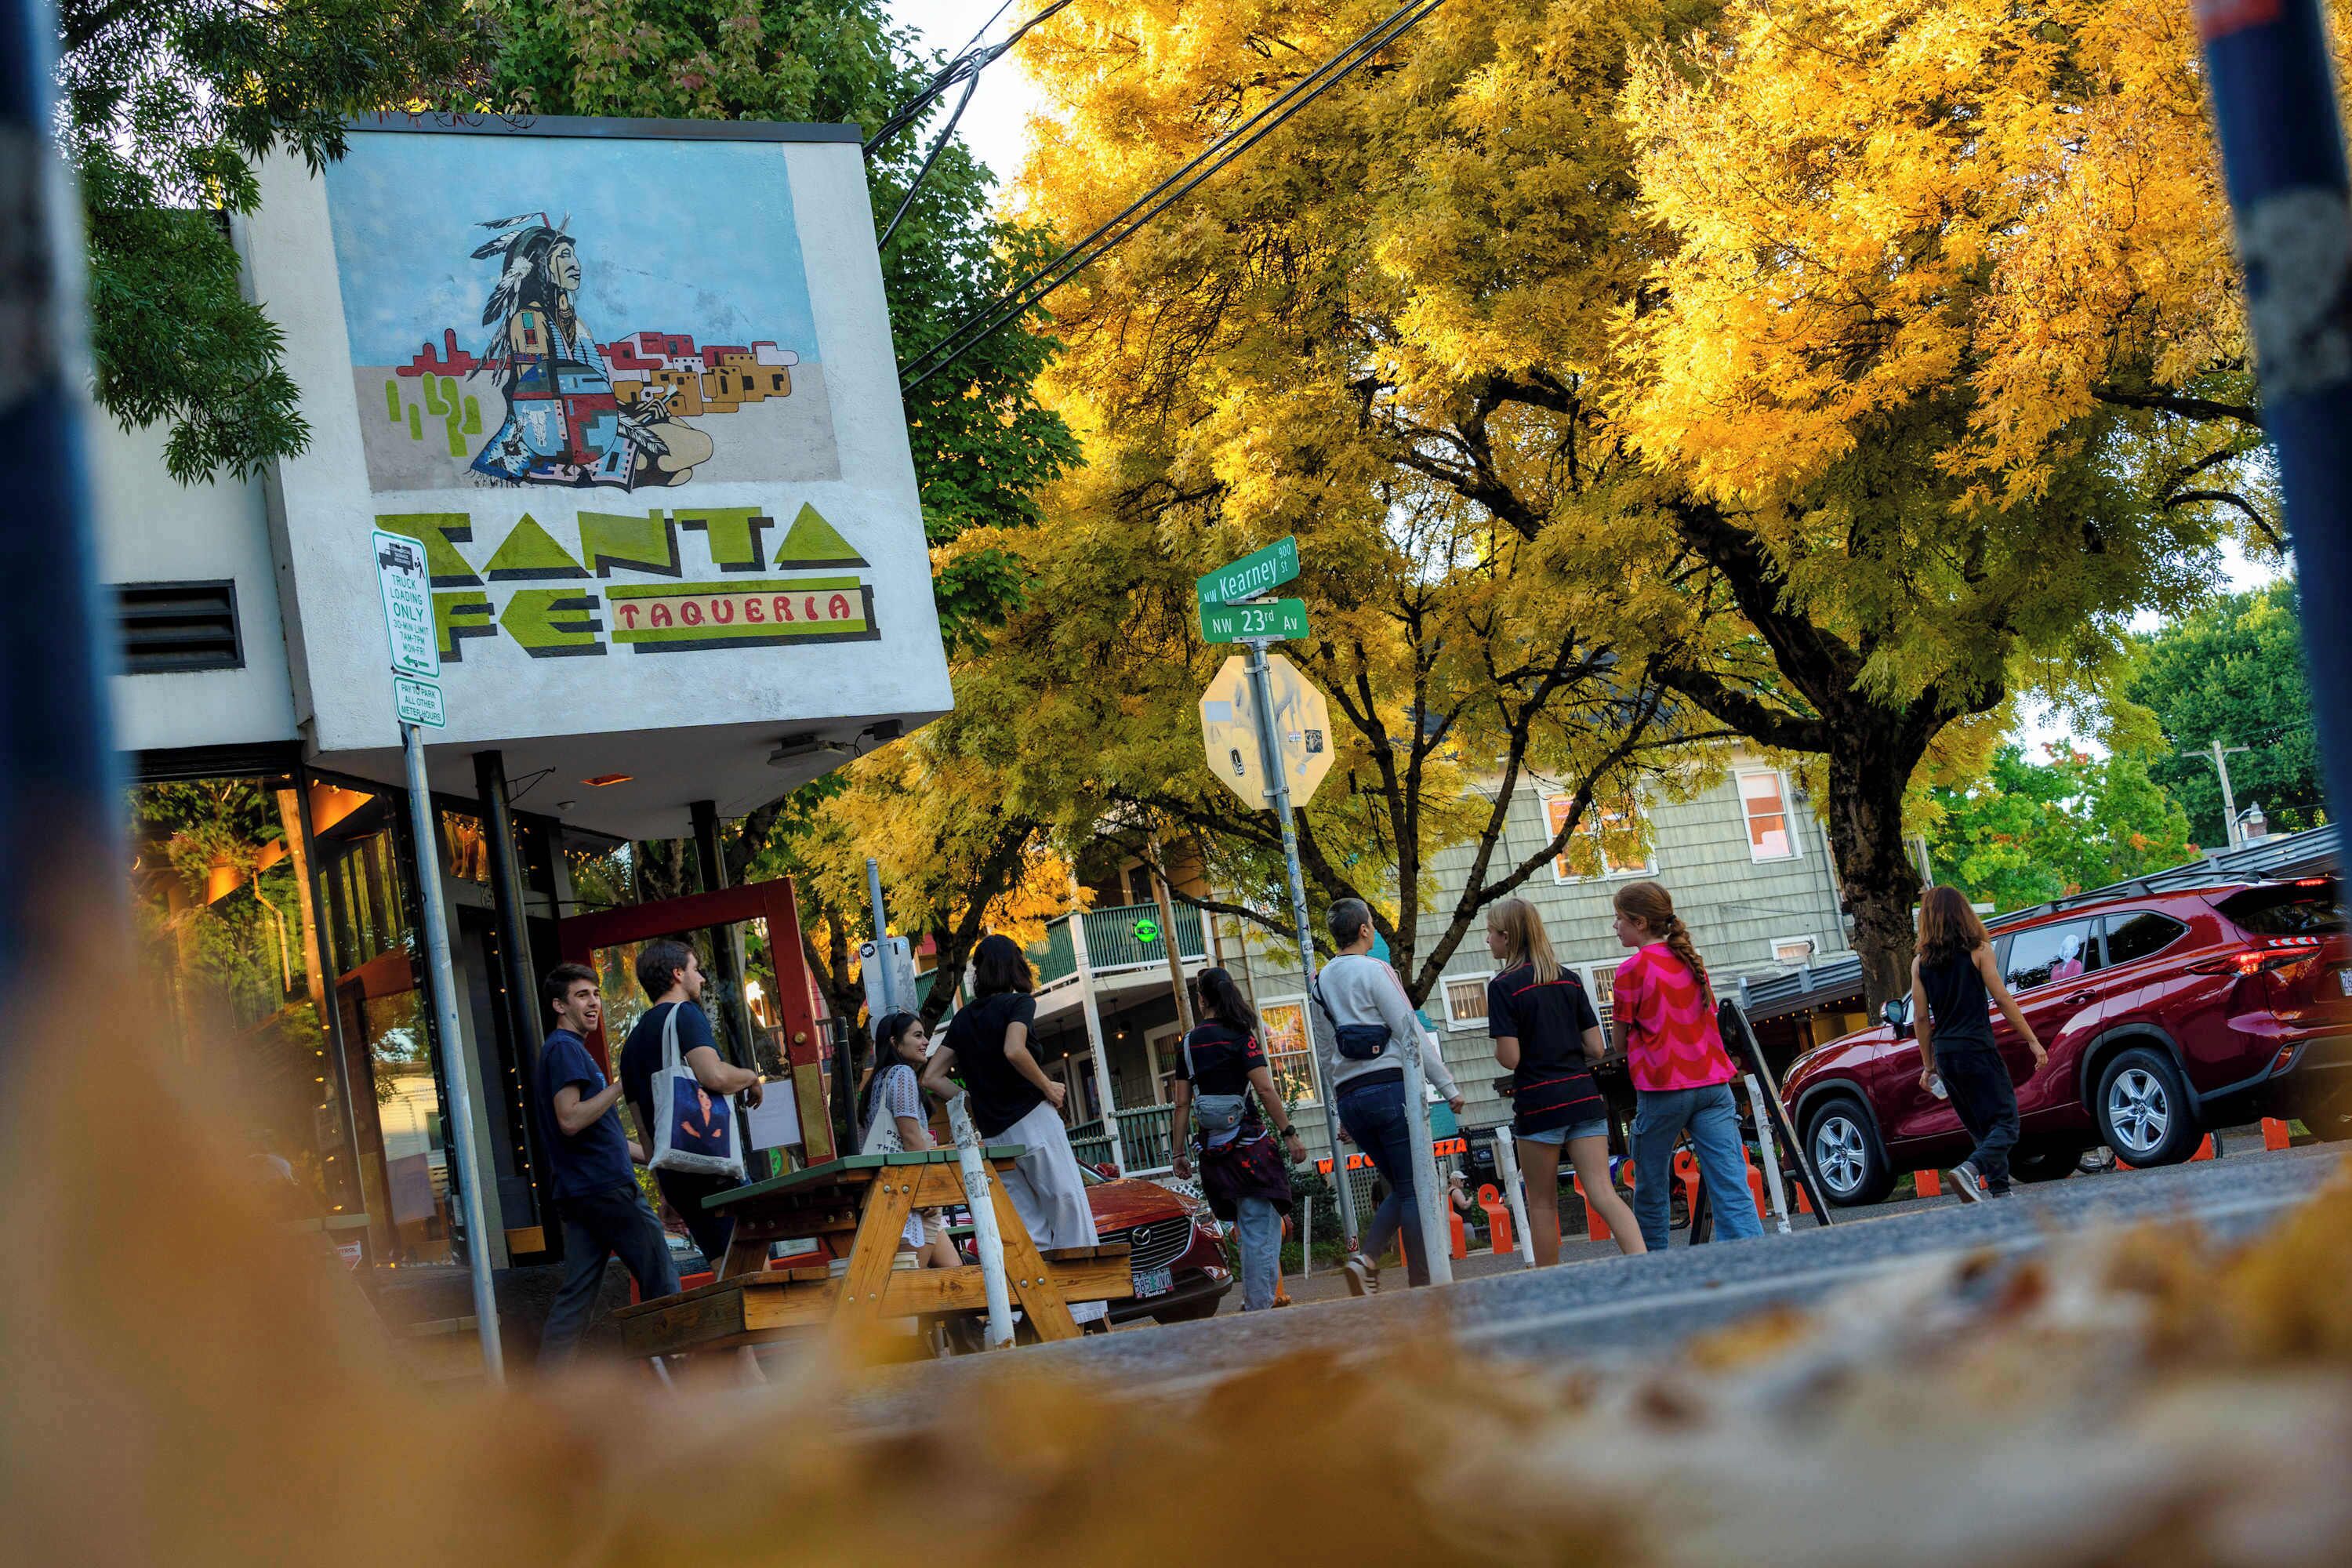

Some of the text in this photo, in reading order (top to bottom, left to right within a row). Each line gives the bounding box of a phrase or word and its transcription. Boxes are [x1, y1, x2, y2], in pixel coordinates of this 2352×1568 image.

[1279, 543, 1291, 559] 900
[392, 574, 416, 590] TRUCK
[1204, 557, 1288, 602] NW Kearney St
[390, 587, 423, 605] LOADING
[394, 602, 423, 622] ONLY
[620, 594, 850, 629] TAQUERIA
[394, 619, 429, 636] 30-MIN LIMIT
[1212, 609, 1298, 633] NW 23rd Av
[400, 630, 424, 644] 7AM-7PM
[402, 643, 425, 655] MON-FRI
[401, 684, 412, 693] PAY
[421, 688, 436, 699] PARK
[405, 695, 436, 709] ALL OTHER
[401, 706, 441, 721] METER HOURS
[1134, 1279, 1150, 1293] 585
